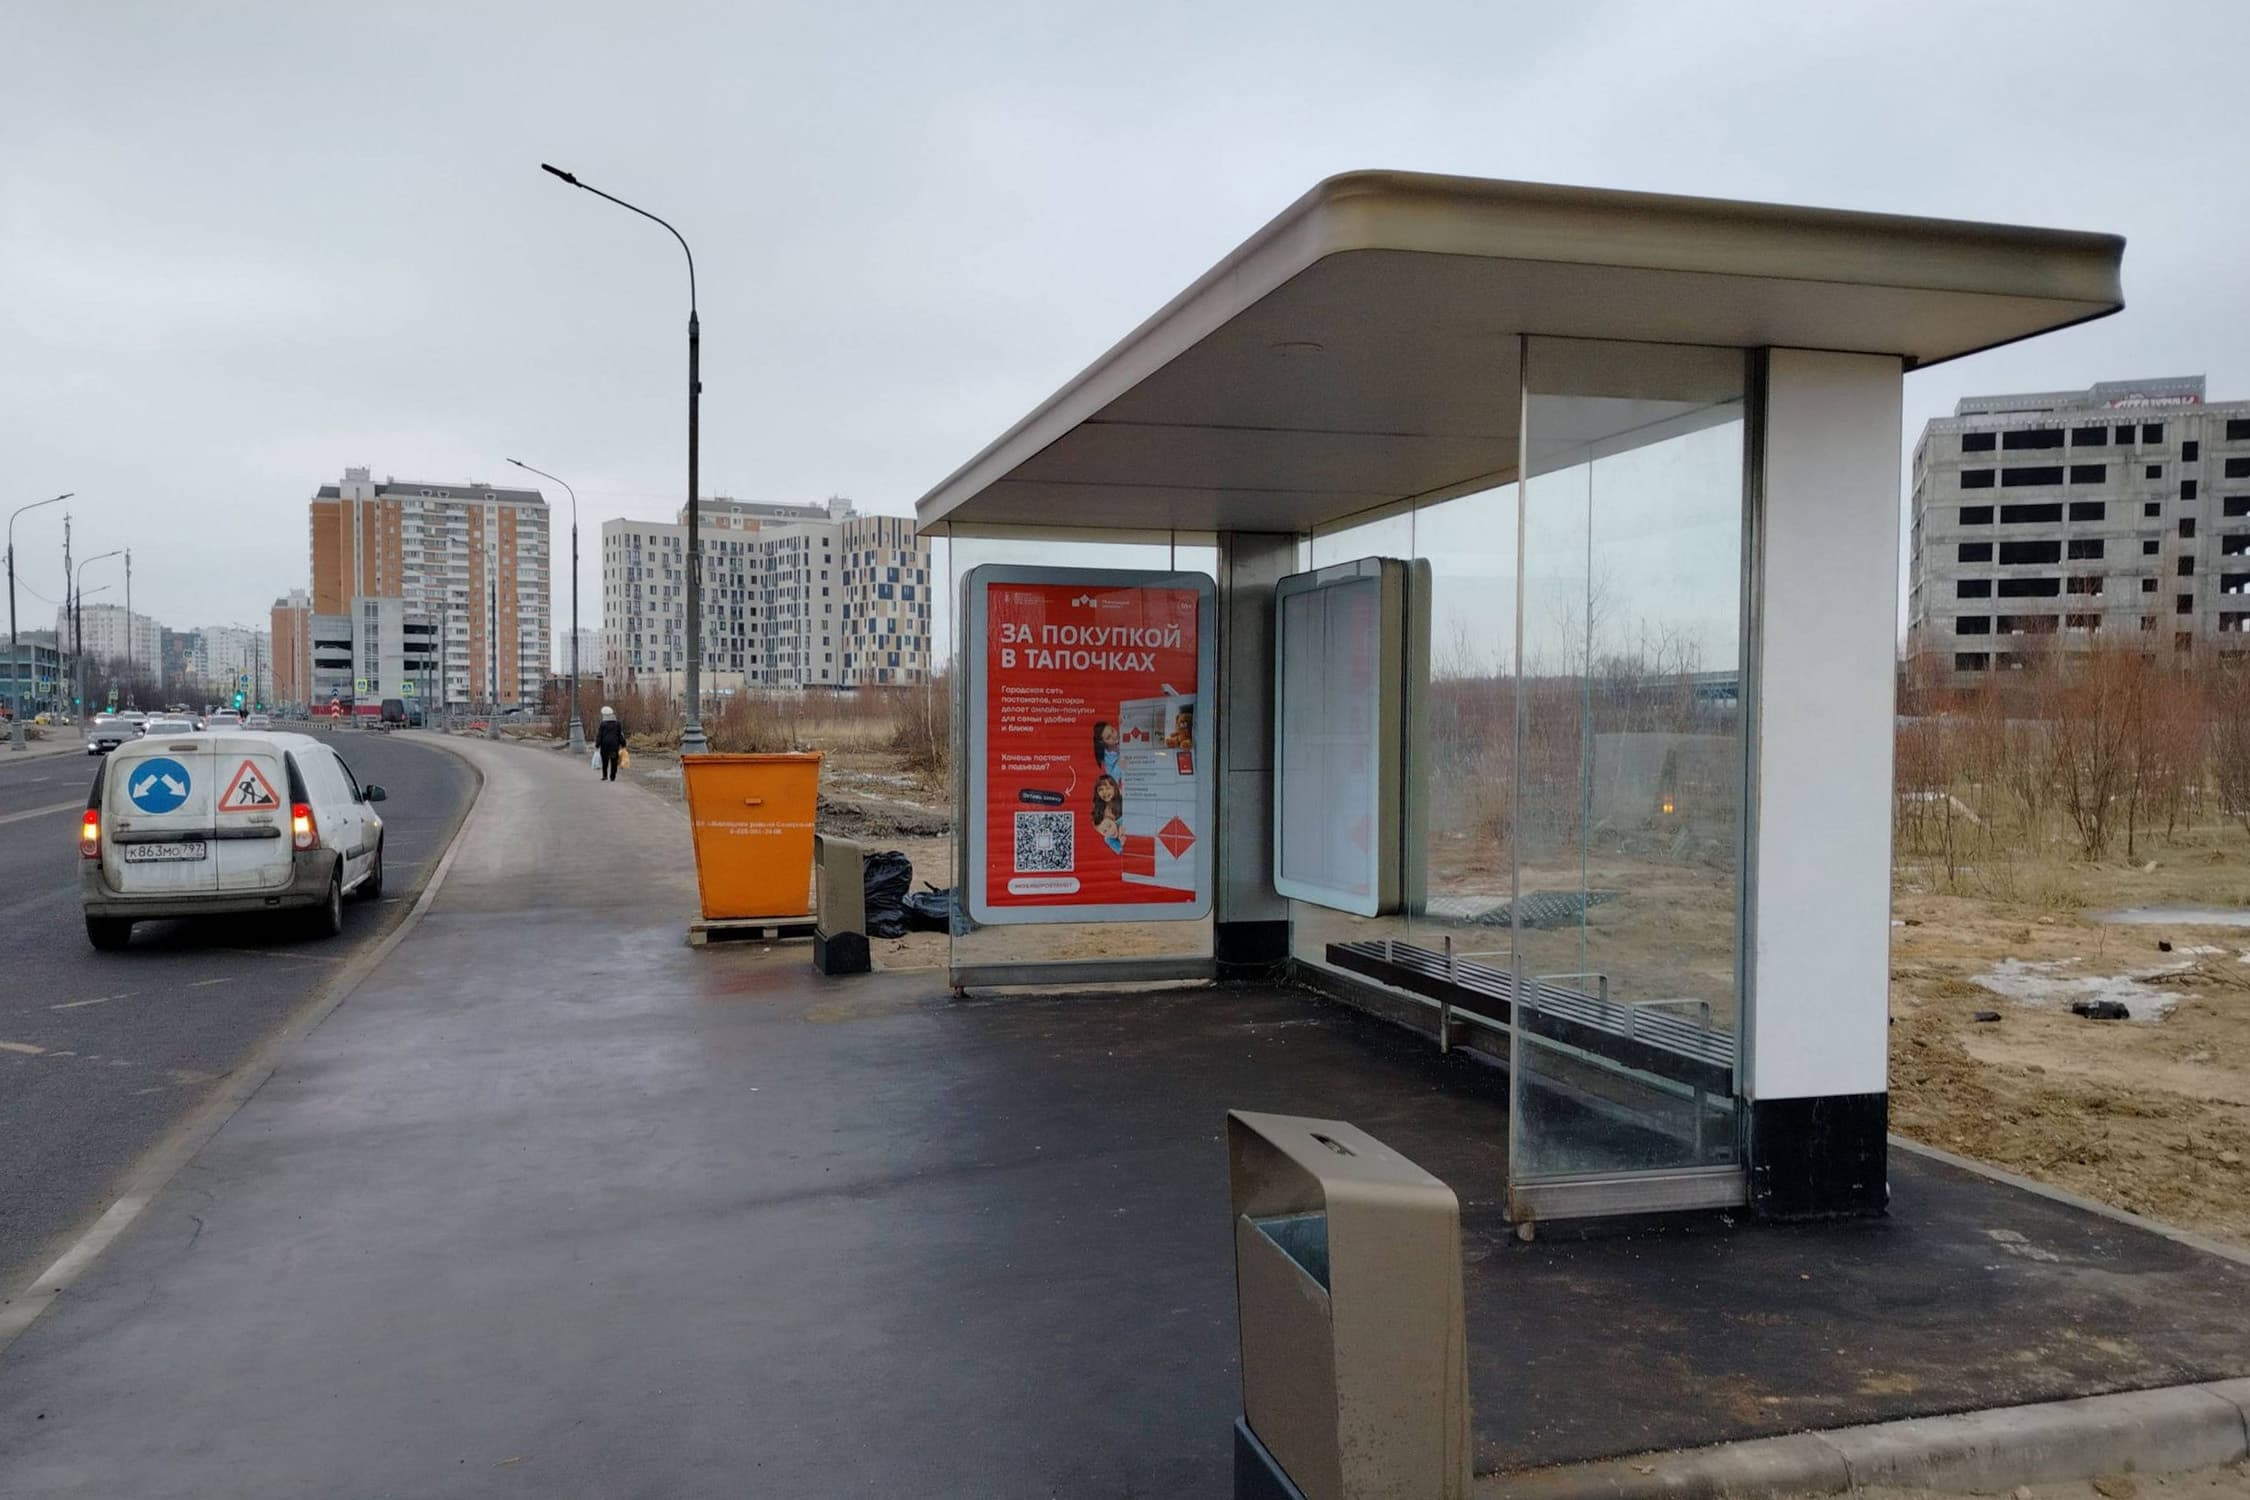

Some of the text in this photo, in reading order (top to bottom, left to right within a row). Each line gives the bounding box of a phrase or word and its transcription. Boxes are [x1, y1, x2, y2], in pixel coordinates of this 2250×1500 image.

[1001, 623, 1181, 649] ЗА ПОКУПКОЙ
[1001, 648, 1156, 672] В ТАПОЧКАХ
[1001, 685, 1044, 695] Городская
[1052, 697, 1085, 705] которая
[1001, 706, 1029, 714] делает
[1044, 715, 1077, 725] удобнее
[1008, 724, 1034, 732] ближе
[1001, 753, 1032, 761] Хочешь
[1008, 763, 1050, 771] подъезде?
